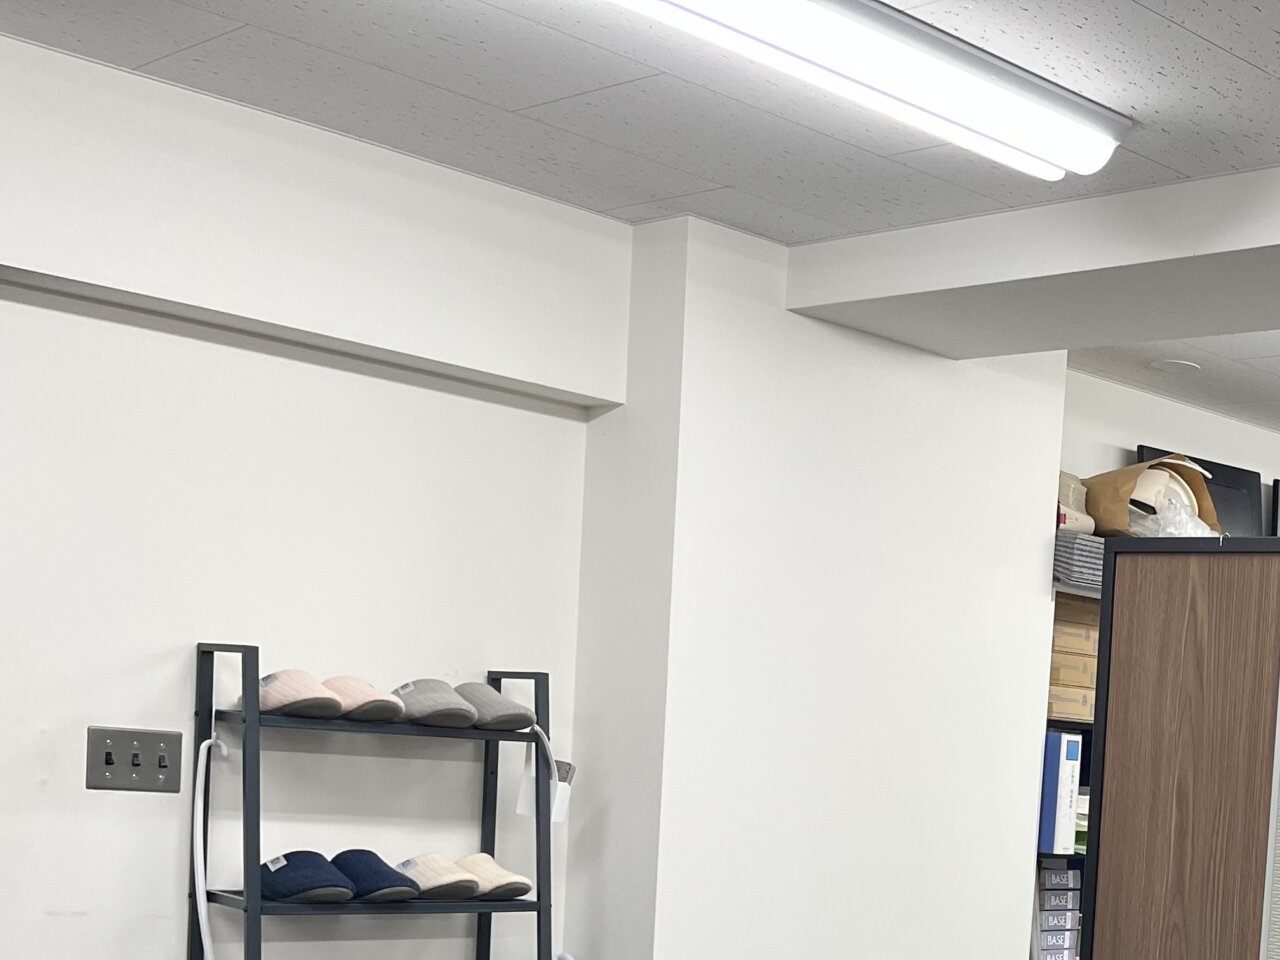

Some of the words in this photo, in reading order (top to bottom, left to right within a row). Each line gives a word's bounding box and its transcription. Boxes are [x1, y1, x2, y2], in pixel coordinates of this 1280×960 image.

[1052, 874, 1068, 884] BASE
[1051, 896, 1067, 905] BASE
[1049, 916, 1066, 926] BASE
[1048, 936, 1065, 945] BASE
